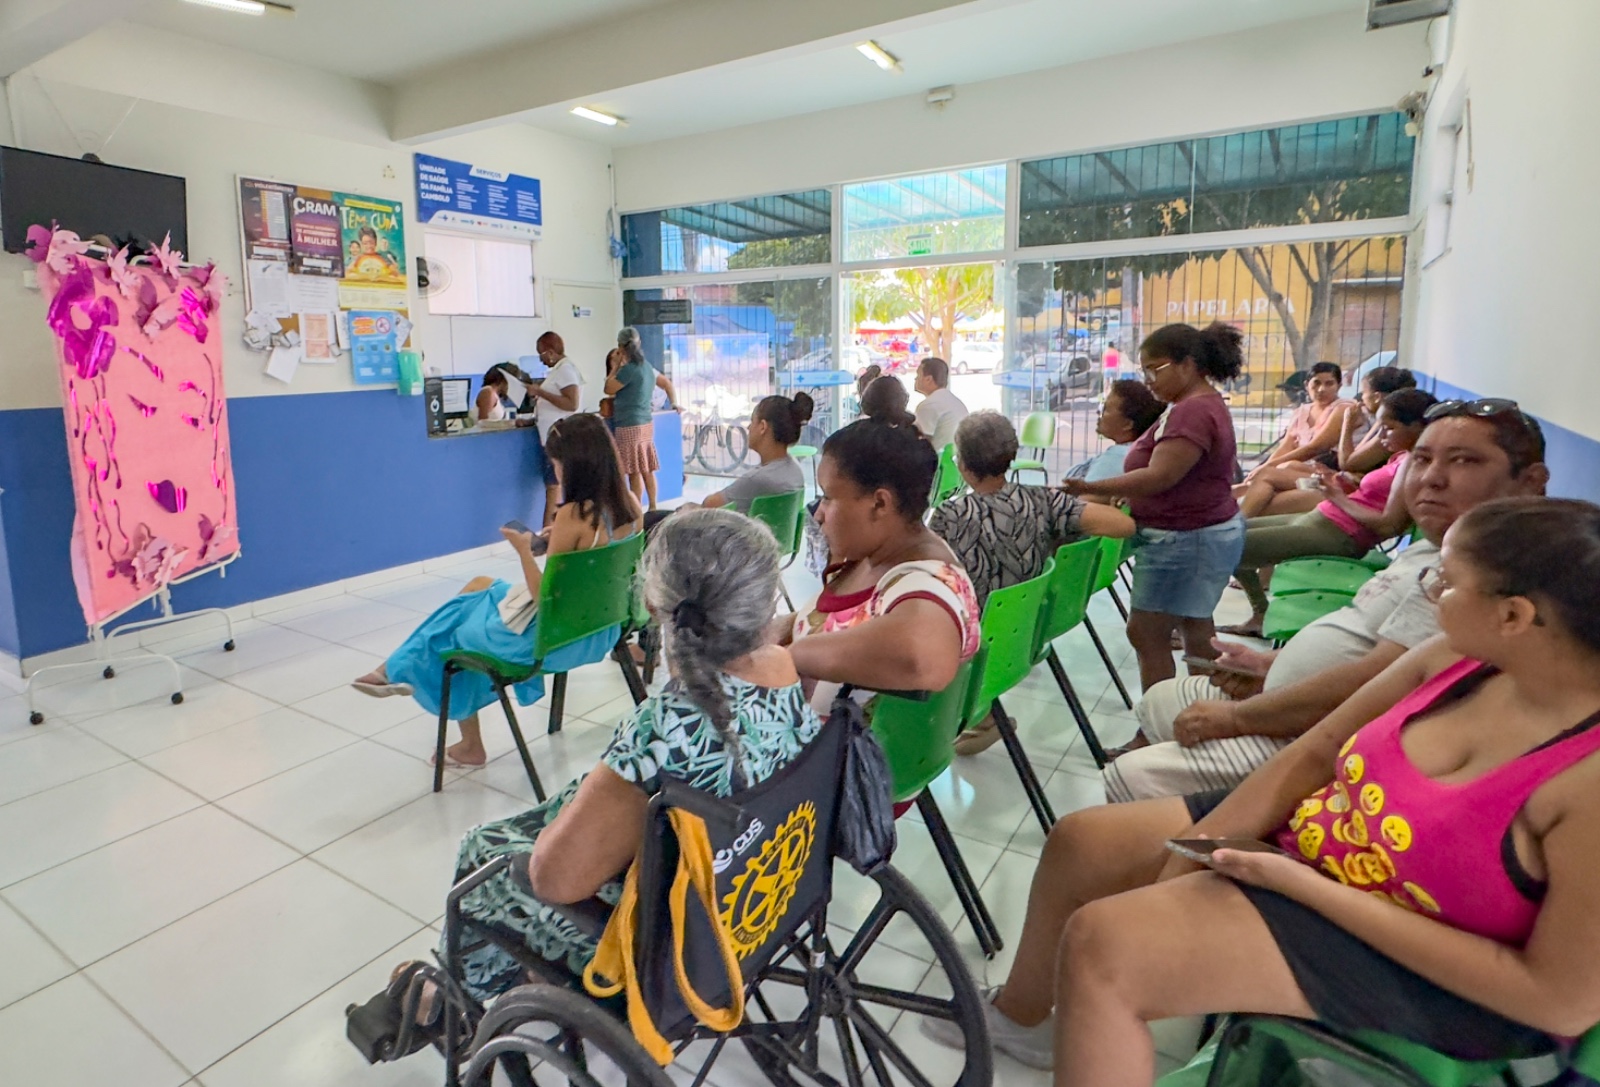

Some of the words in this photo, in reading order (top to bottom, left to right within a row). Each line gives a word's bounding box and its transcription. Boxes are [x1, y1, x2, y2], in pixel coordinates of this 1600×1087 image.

[419, 164, 446, 175] UNIDADE
[476, 169, 501, 178] SERVIÇOS
[420, 173, 428, 181] DE
[429, 173, 449, 185] SAÚDE
[429, 184, 453, 194] FAMÍLIA
[292, 198, 337, 217] CRAM
[304, 236, 338, 246] MULHER
[1166, 297, 1295, 316] PAPELARA
[733, 818, 762, 851] CDS
